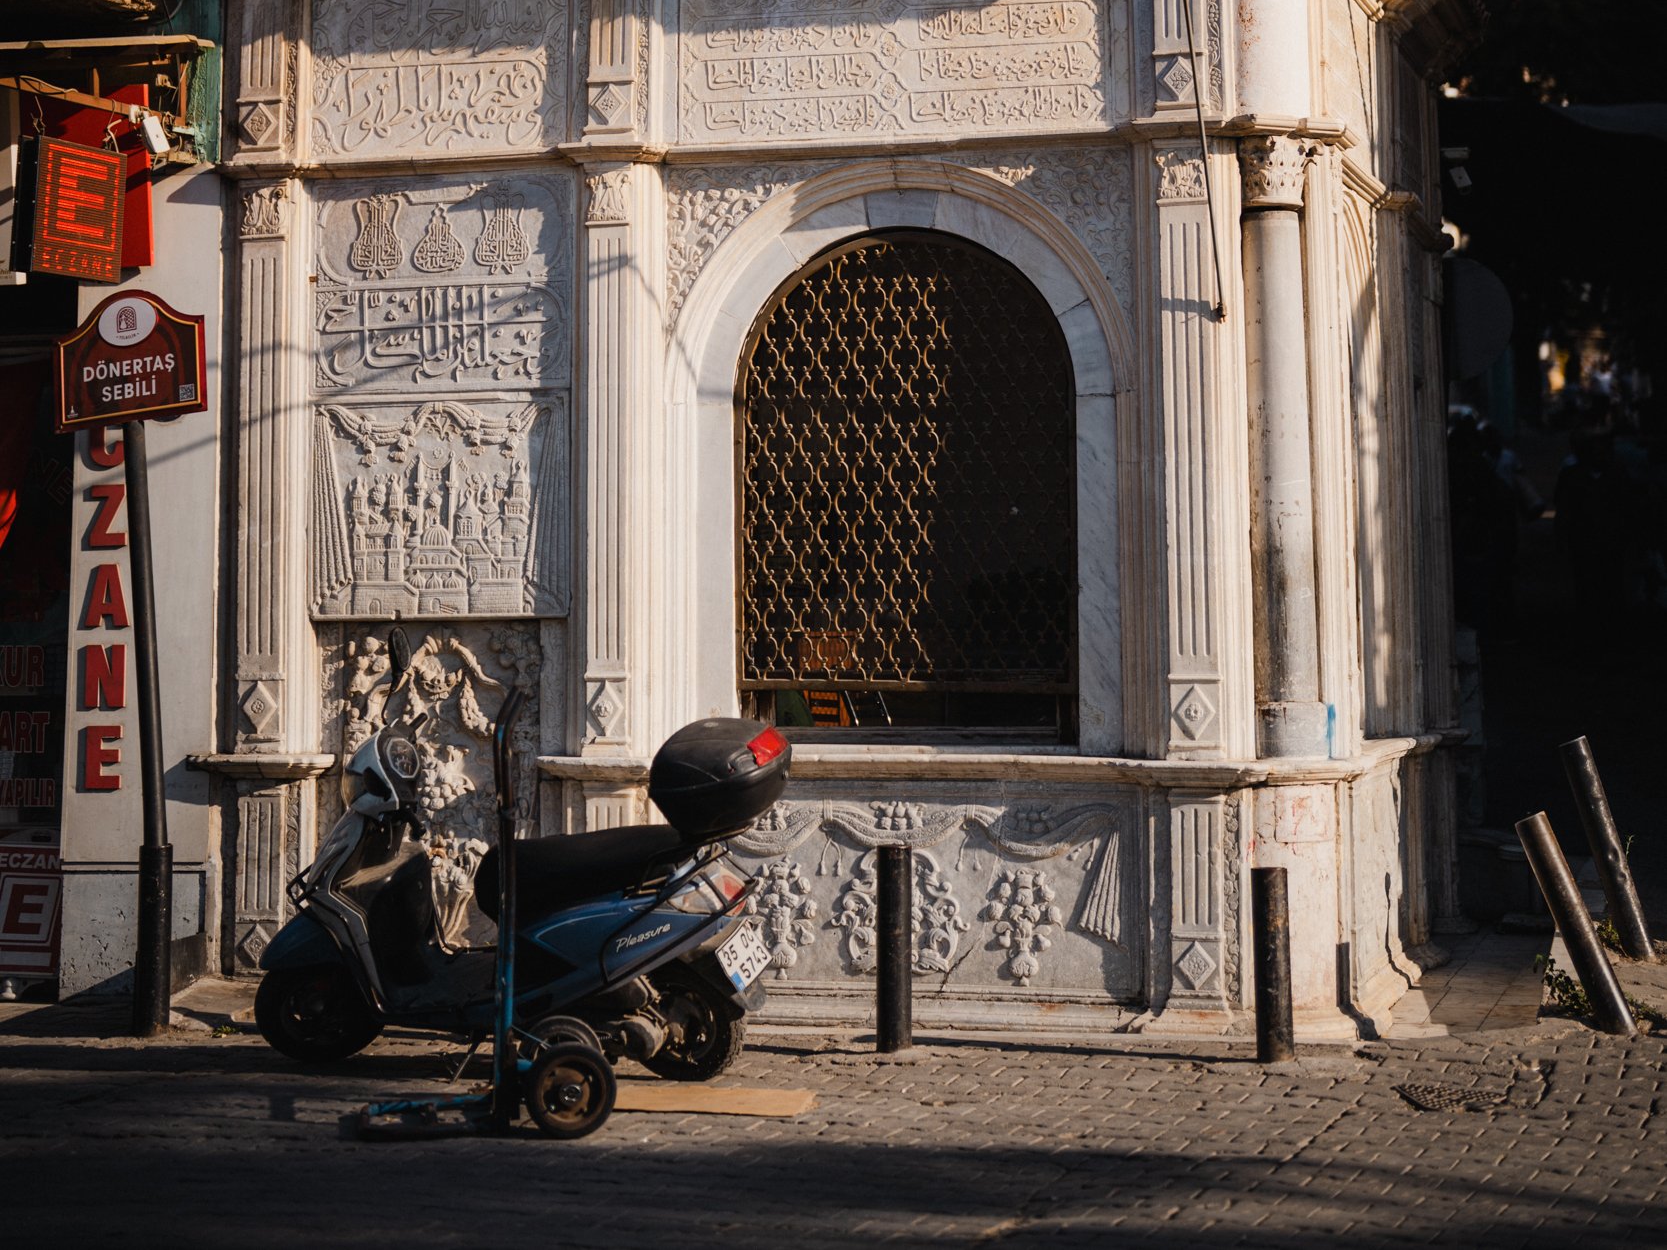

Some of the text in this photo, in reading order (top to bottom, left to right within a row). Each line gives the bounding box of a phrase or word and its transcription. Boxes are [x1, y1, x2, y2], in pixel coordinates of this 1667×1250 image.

[57, 156, 108, 237] E
[41, 247, 114, 278] ECZANE
[83, 353, 175, 383] DÖNERTAŞ
[101, 375, 157, 402] SEBİLİ
[83, 424, 129, 790] CZANE
[0, 852, 60, 870] ECZAN
[2, 883, 49, 934] E
[616, 921, 671, 953] Pleasure
[722, 944, 738, 967] 35
[739, 945, 768, 979] 5743
